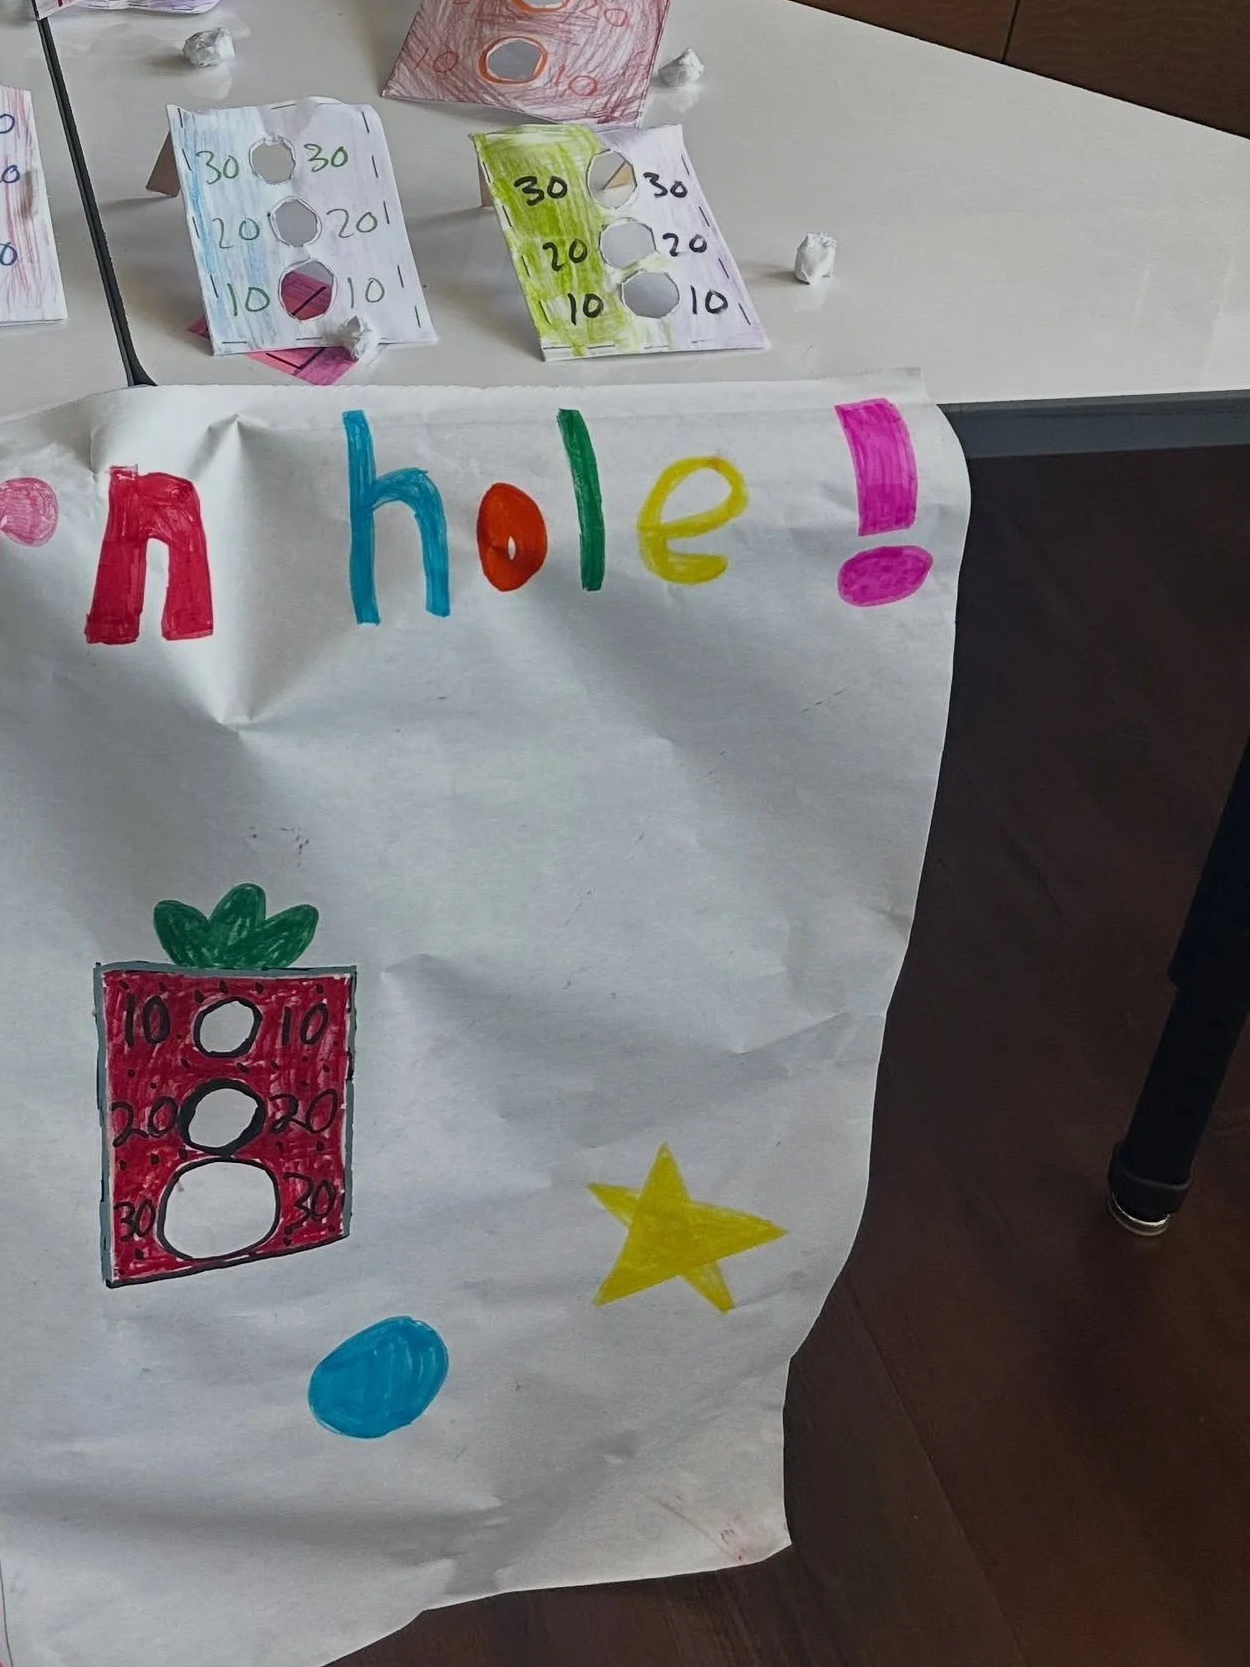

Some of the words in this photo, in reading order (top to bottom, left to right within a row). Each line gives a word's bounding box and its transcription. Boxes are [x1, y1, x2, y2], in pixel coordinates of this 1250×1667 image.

[195, 150, 240, 185] 30
[303, 143, 349, 172] 30
[513, 175, 569, 207] 30
[642, 171, 688, 199] 30
[212, 217, 261, 249] 20
[326, 208, 378, 238] 20
[542, 238, 588, 272] 20
[662, 232, 708, 257] 20
[226, 282, 271, 317] 10
[347, 276, 385, 309] 10
[566, 292, 605, 326] 10
[690, 284, 729, 316] 10
[342, 397, 934, 624] hole!
[123, 994, 173, 1049] 10
[281, 1001, 330, 1048] 10
[110, 1093, 180, 1149] 20
[268, 1088, 338, 1136] 20
[113, 1197, 156, 1243] 30
[282, 1170, 337, 1235] 30
